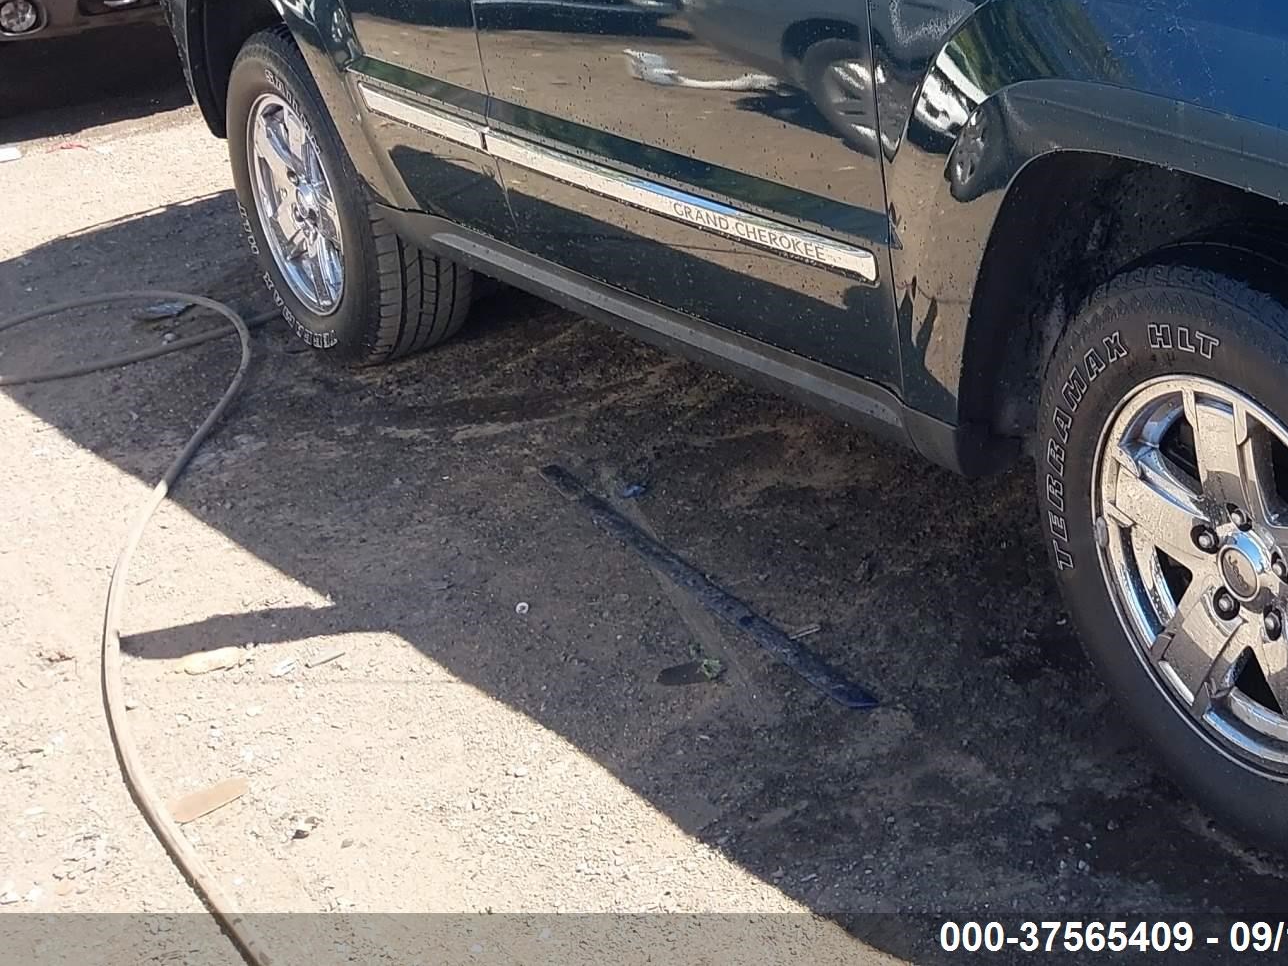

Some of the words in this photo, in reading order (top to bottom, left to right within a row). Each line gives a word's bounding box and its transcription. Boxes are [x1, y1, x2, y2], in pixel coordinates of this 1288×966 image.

[672, 202, 730, 231] GRAND
[734, 222, 827, 262] CHEROKEE
[1046, 332, 1128, 571] TERRAMAX
[1148, 324, 1219, 359] HLT
